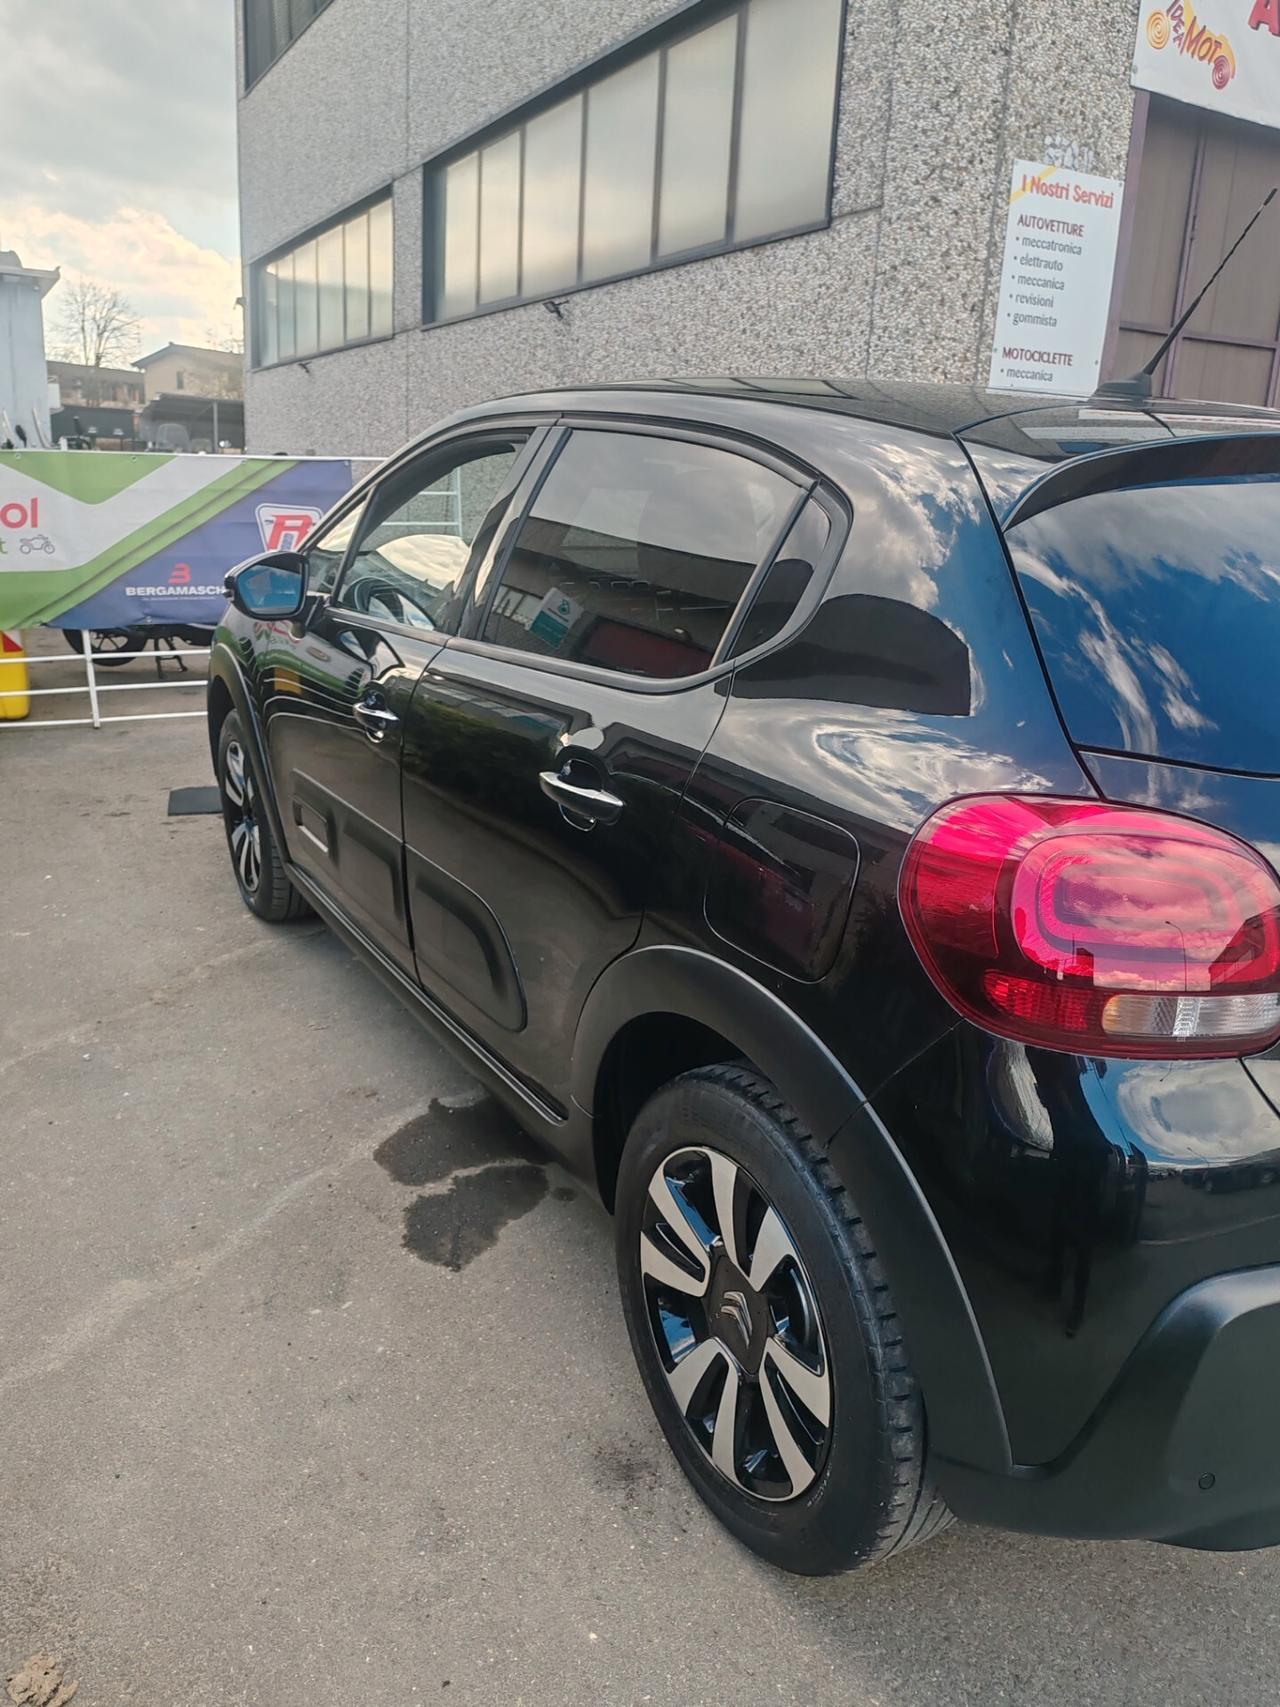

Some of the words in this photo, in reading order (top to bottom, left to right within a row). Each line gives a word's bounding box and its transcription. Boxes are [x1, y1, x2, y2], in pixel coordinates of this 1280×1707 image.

[1021, 175, 1027, 192] I
[1030, 175, 1071, 200] Nostri
[1072, 184, 1115, 209] Servizi
[1016, 214, 1085, 238] AUTOVETTURE
[1021, 236, 1083, 256] meccatronica
[1019, 253, 1064, 272] elettrauto
[1017, 275, 1065, 291] meccanica
[1015, 293, 1055, 308] revisioni
[1012, 312, 1058, 328] gommista
[1002, 346, 1074, 367] MOTOCICLETTE
[1006, 368, 1054, 382] meccanica
